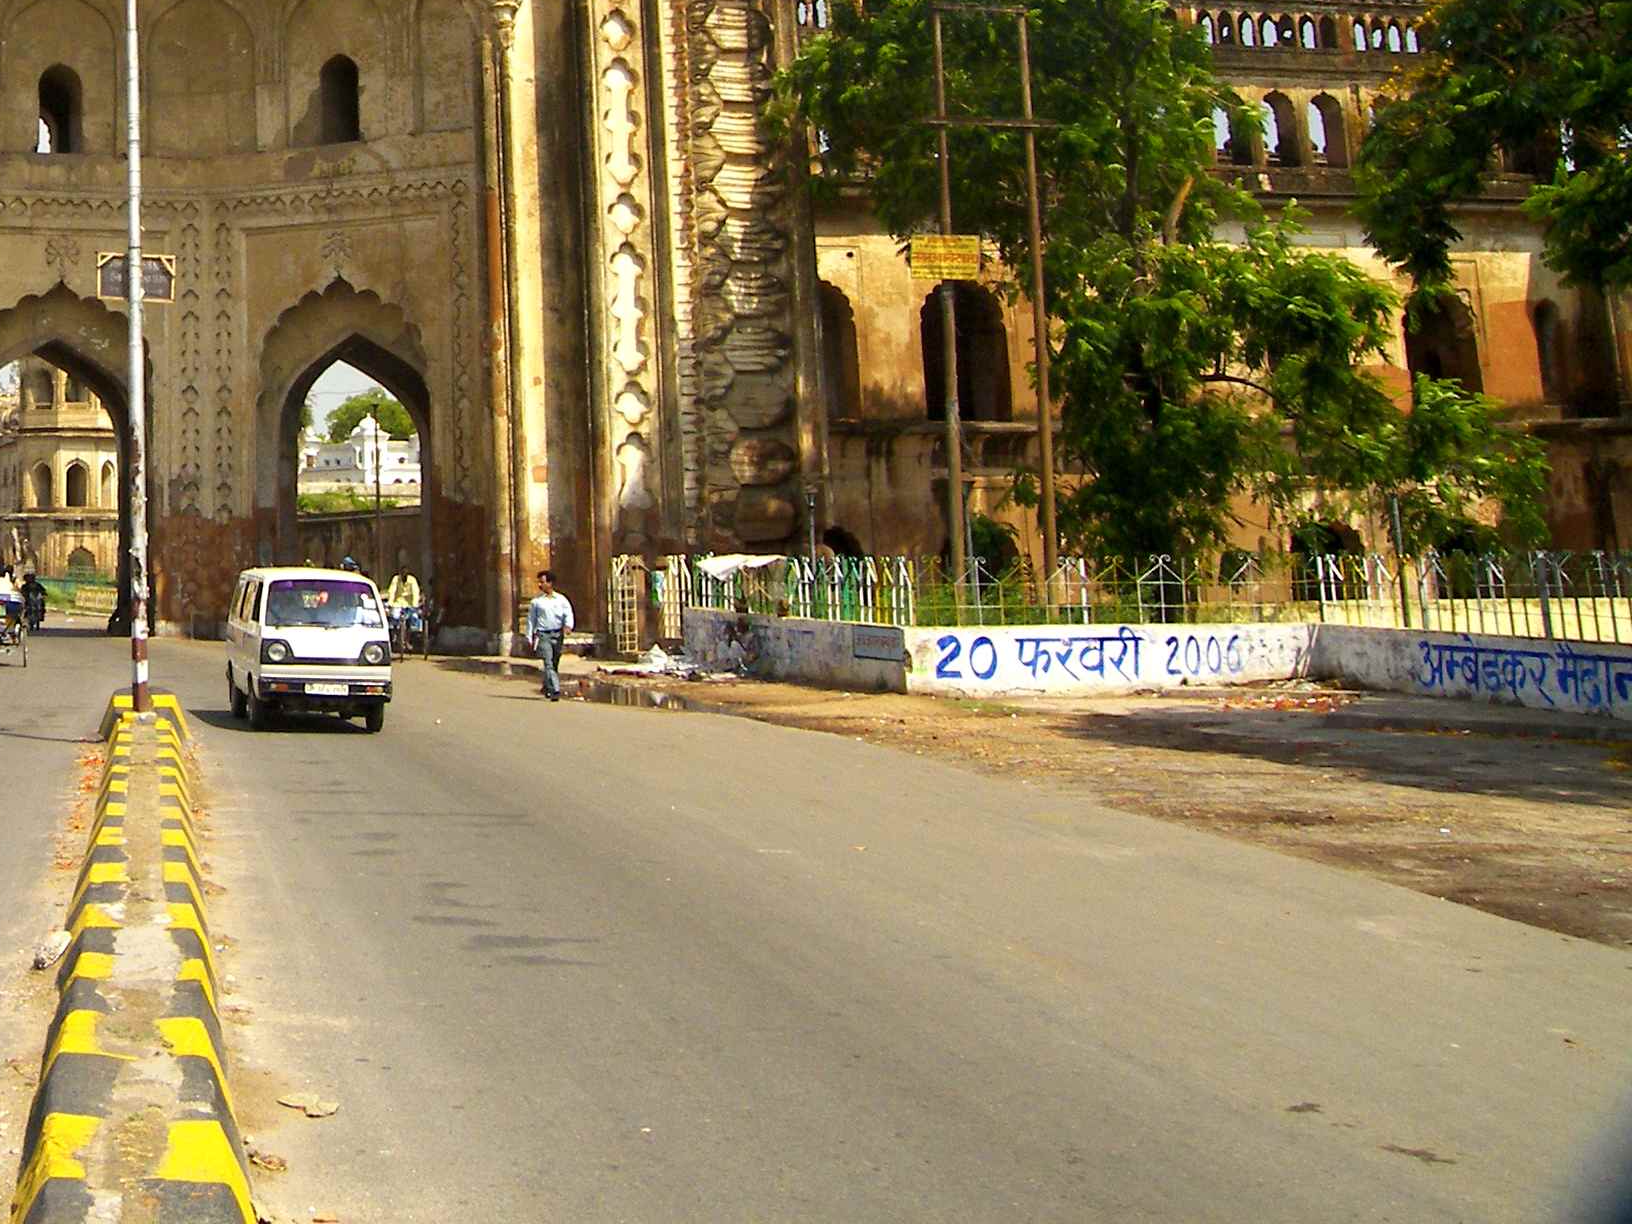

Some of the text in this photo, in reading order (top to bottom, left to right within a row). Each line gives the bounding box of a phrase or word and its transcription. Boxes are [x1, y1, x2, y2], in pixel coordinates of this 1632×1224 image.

[936, 626, 1244, 681] 20 फरवरी 2006
[1418, 633, 1555, 706] अम्बेडकर
